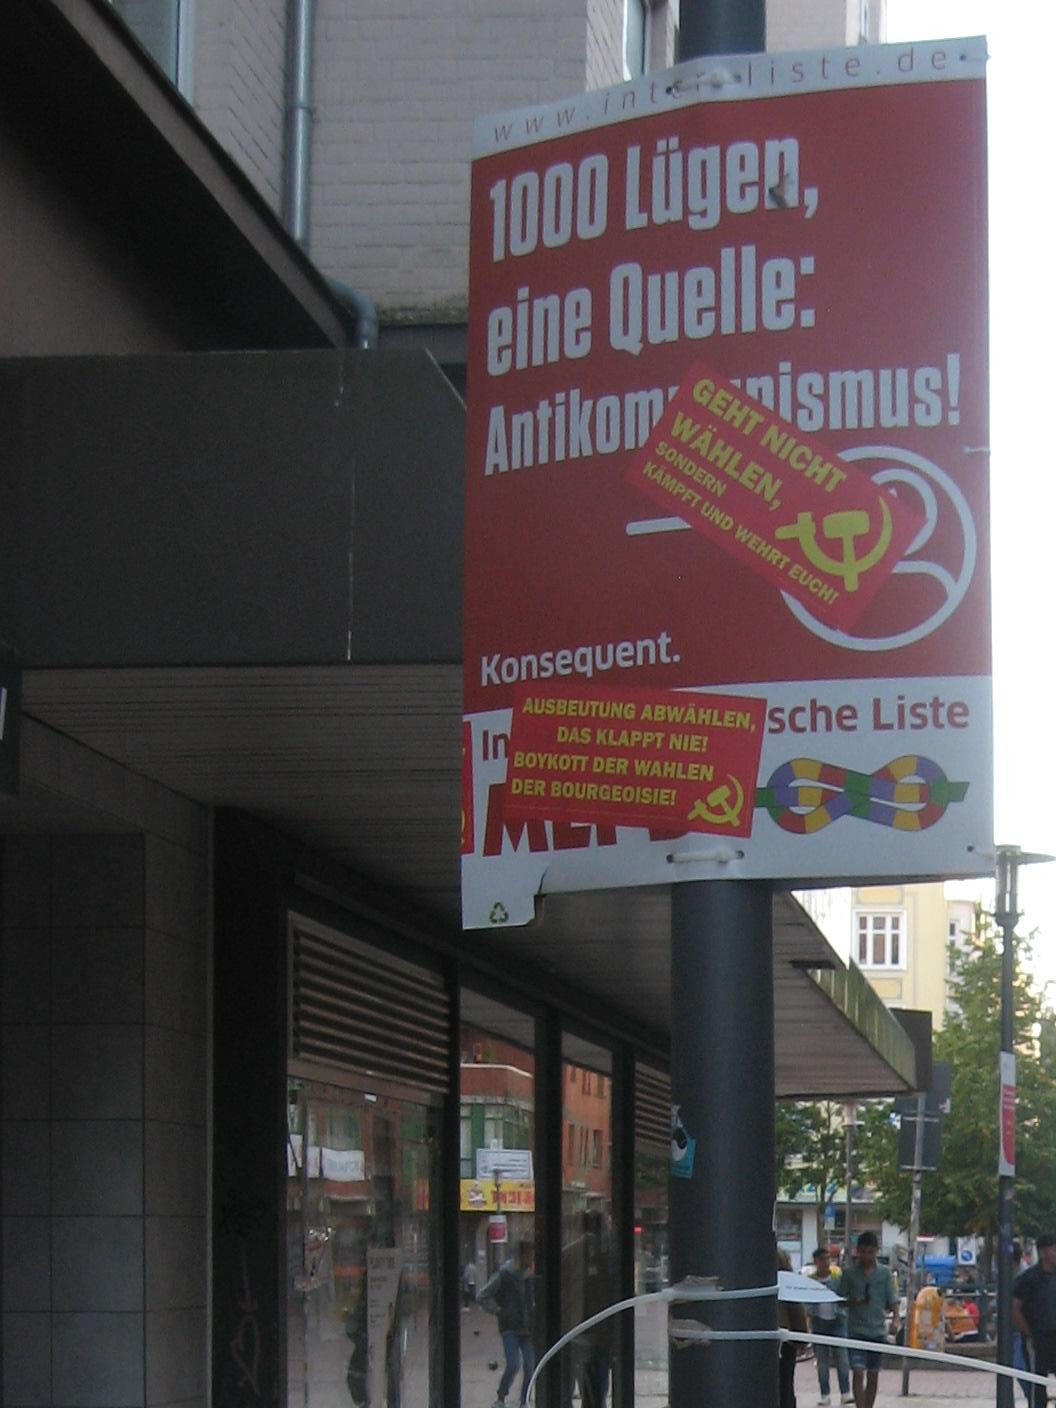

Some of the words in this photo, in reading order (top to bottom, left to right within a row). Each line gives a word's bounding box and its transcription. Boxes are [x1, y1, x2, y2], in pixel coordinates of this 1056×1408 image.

[494, 46, 947, 143] www.intrliste.de
[489, 153, 609, 263] 1000
[624, 135, 819, 231] Lügen,
[486, 286, 592, 377] eine
[609, 244, 816, 357] Quelle:
[484, 352, 961, 477] Antikomnismus!
[692, 378, 765, 436] GEHT
[759, 425, 848, 493] NICHT
[655, 441, 728, 498] SONDERN
[670, 411, 783, 512] WÄHLEN,
[642, 461, 703, 508] KÄMPFT
[700, 502, 735, 531] UND
[734, 525, 791, 570] WEHRT
[788, 563, 840, 605] EUCH!
[480, 630, 682, 687] Konsequent.
[522, 697, 636, 720] AUSBEUTUNG
[641, 703, 757, 733] ABWÄHLEN,
[557, 726, 592, 744] DAS
[596, 728, 666, 749] KLAPPT
[669, 735, 709, 753] NIE!
[871, 694, 971, 732] Liste
[511, 778, 546, 796] DER
[551, 779, 678, 806] BOURGEOISIE!
[513, 752, 588, 773] BOYKOTT
[593, 756, 629, 775] DER
[634, 760, 715, 782] WAHLEN
